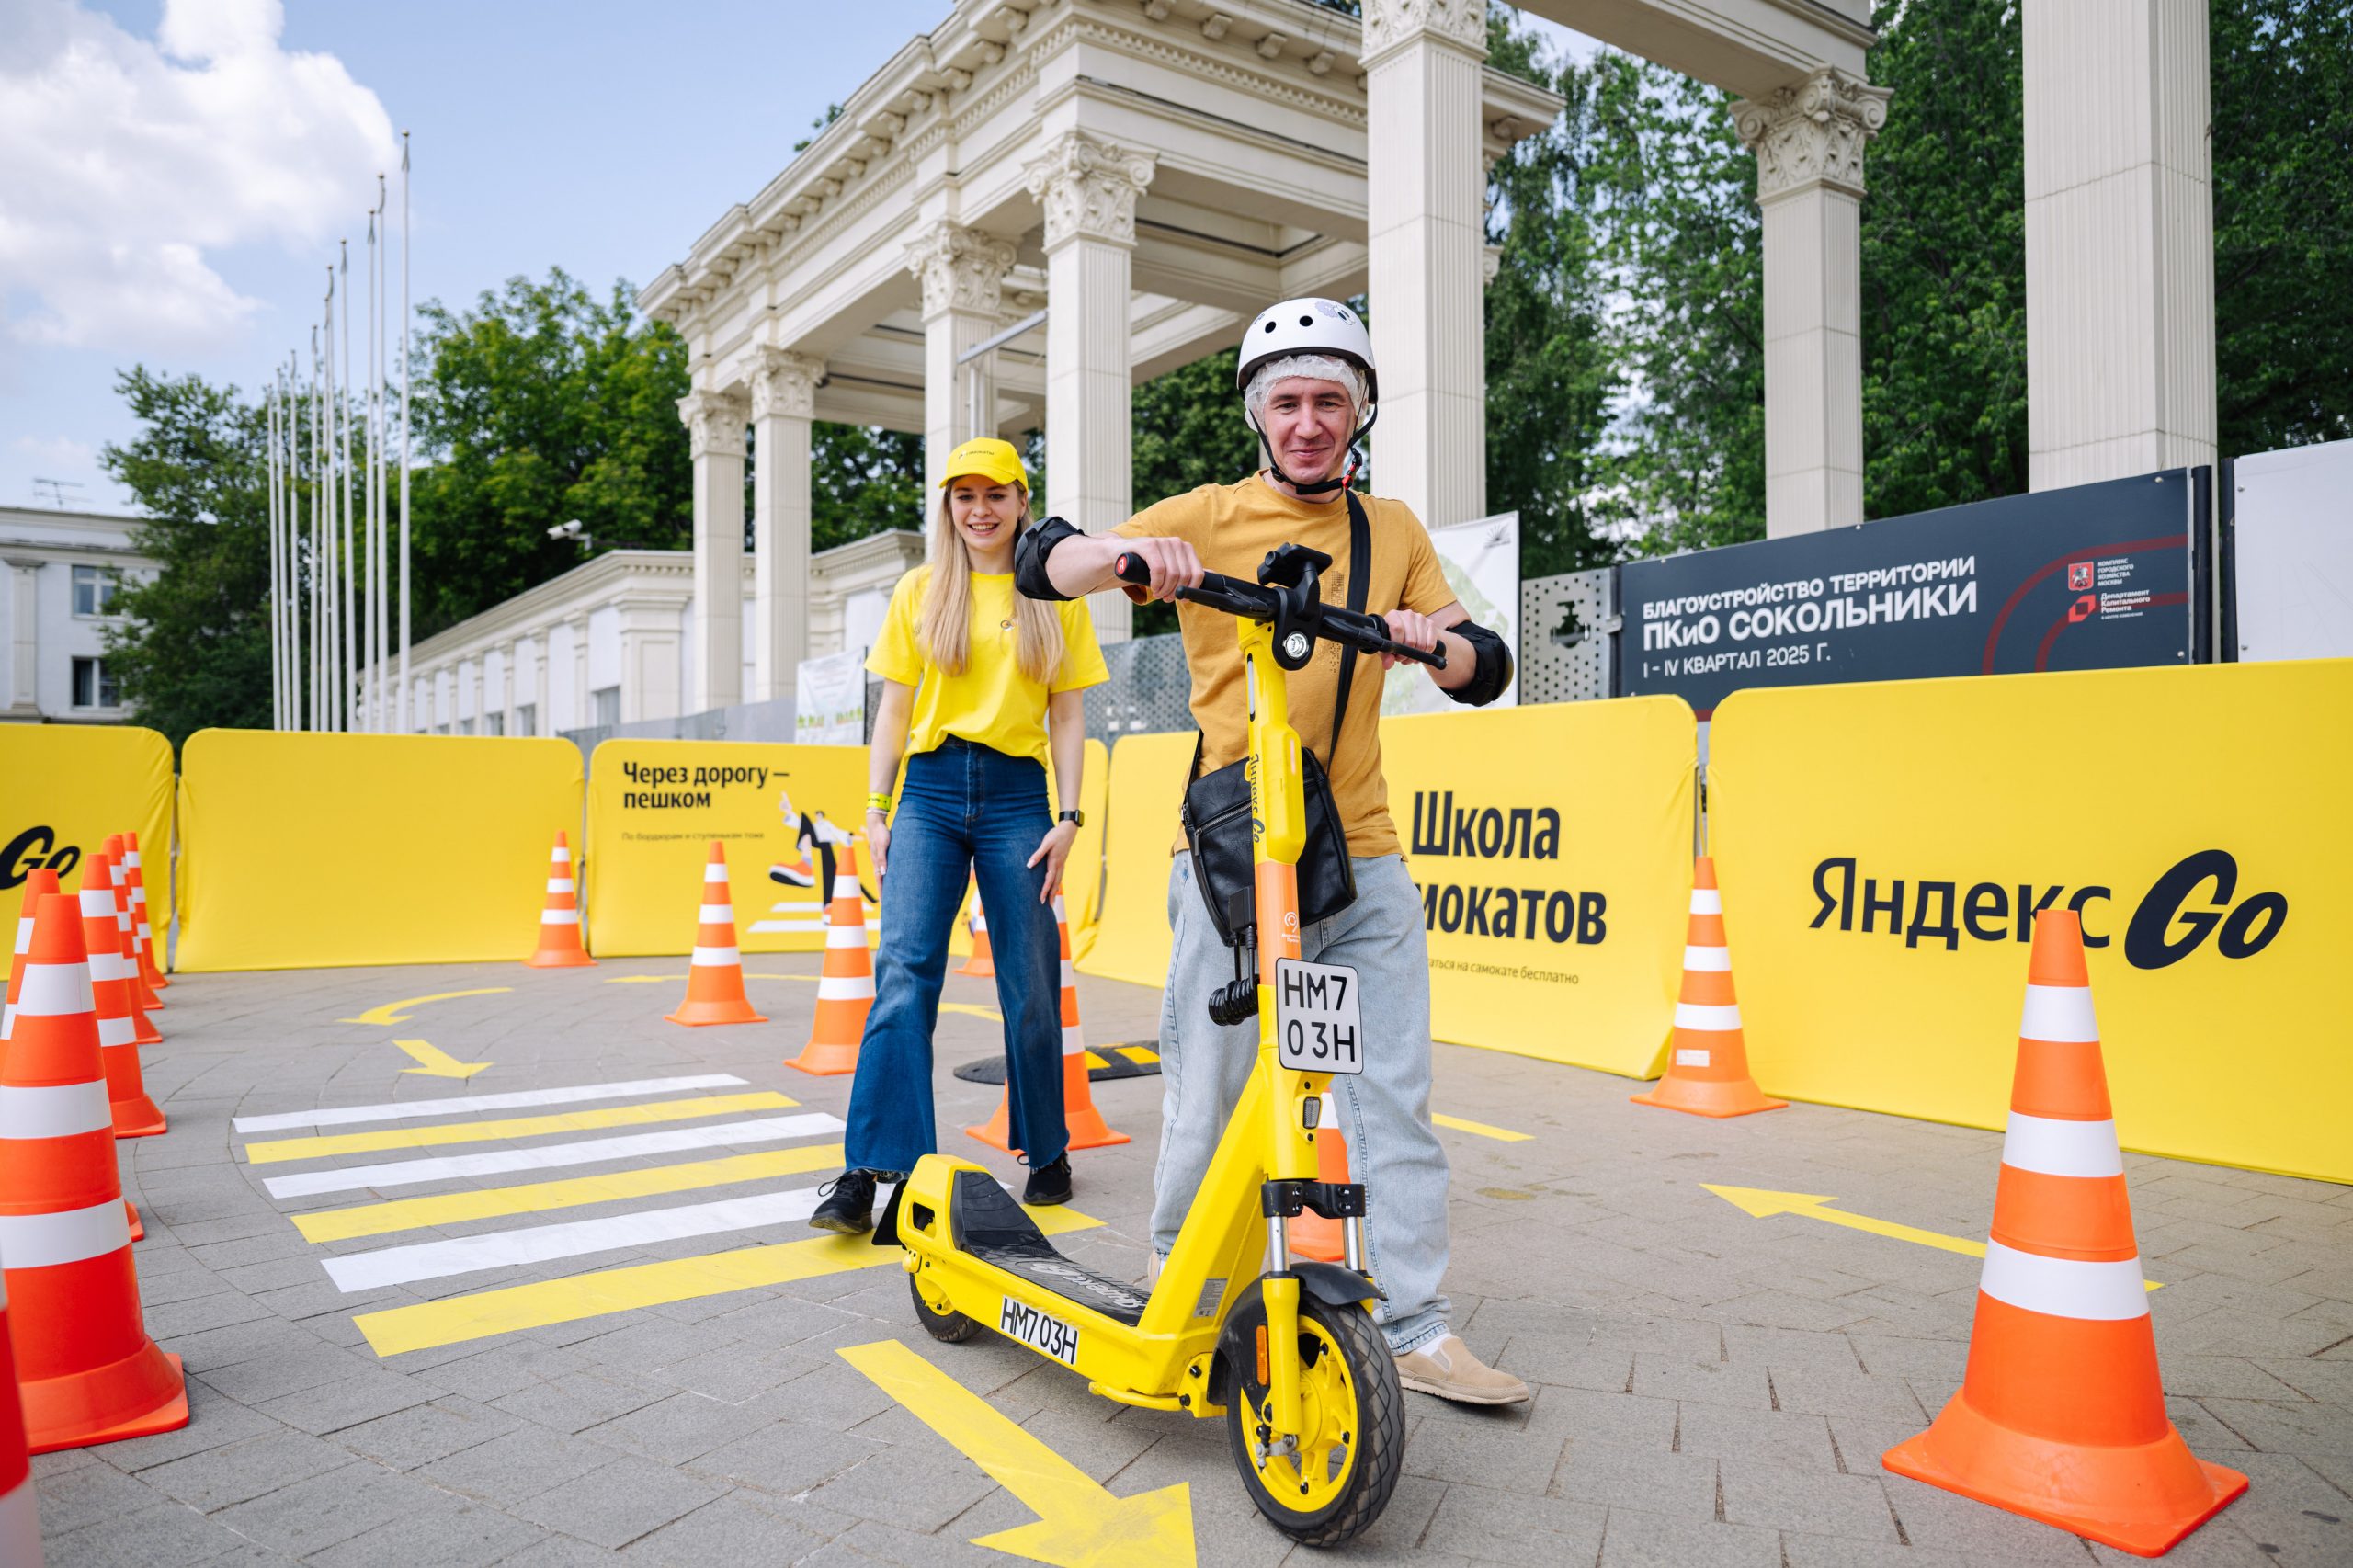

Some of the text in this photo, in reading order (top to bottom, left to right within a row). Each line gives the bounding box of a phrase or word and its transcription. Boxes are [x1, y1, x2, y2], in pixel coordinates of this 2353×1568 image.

[2097, 558, 2129, 567] КОМПЛЕКС
[2097, 564, 2134, 574] ГОРОДСКОГО
[1643, 555, 1975, 619] БЛАГОУСТРОЙСТВО ТЕРРИТОРИИ
[2097, 578, 2123, 586] МОСКВЫ
[2101, 589, 2150, 601] Департамент
[2101, 597, 2151, 607] Капитального
[2101, 606, 2132, 614] Ремонта
[1643, 581, 1977, 651] ПКиО СОКОЛЬНИКИ
[1683, 650, 1760, 675] КВАРТАЛ
[1766, 644, 1809, 666] 2025
[1817, 642, 1831, 662] Г.
[623, 761, 688, 789] Через
[693, 767, 768, 789] дорогу
[623, 791, 711, 809] пешком
[1411, 790, 1562, 860] Школа
[0, 825, 81, 890] Go
[1808, 849, 2289, 971] Яндекс Go
[1457, 961, 1469, 971] на
[1471, 962, 1518, 978] самокате
[1521, 966, 1579, 985] бесплатно
[1284, 968, 1347, 1011] НМ7
